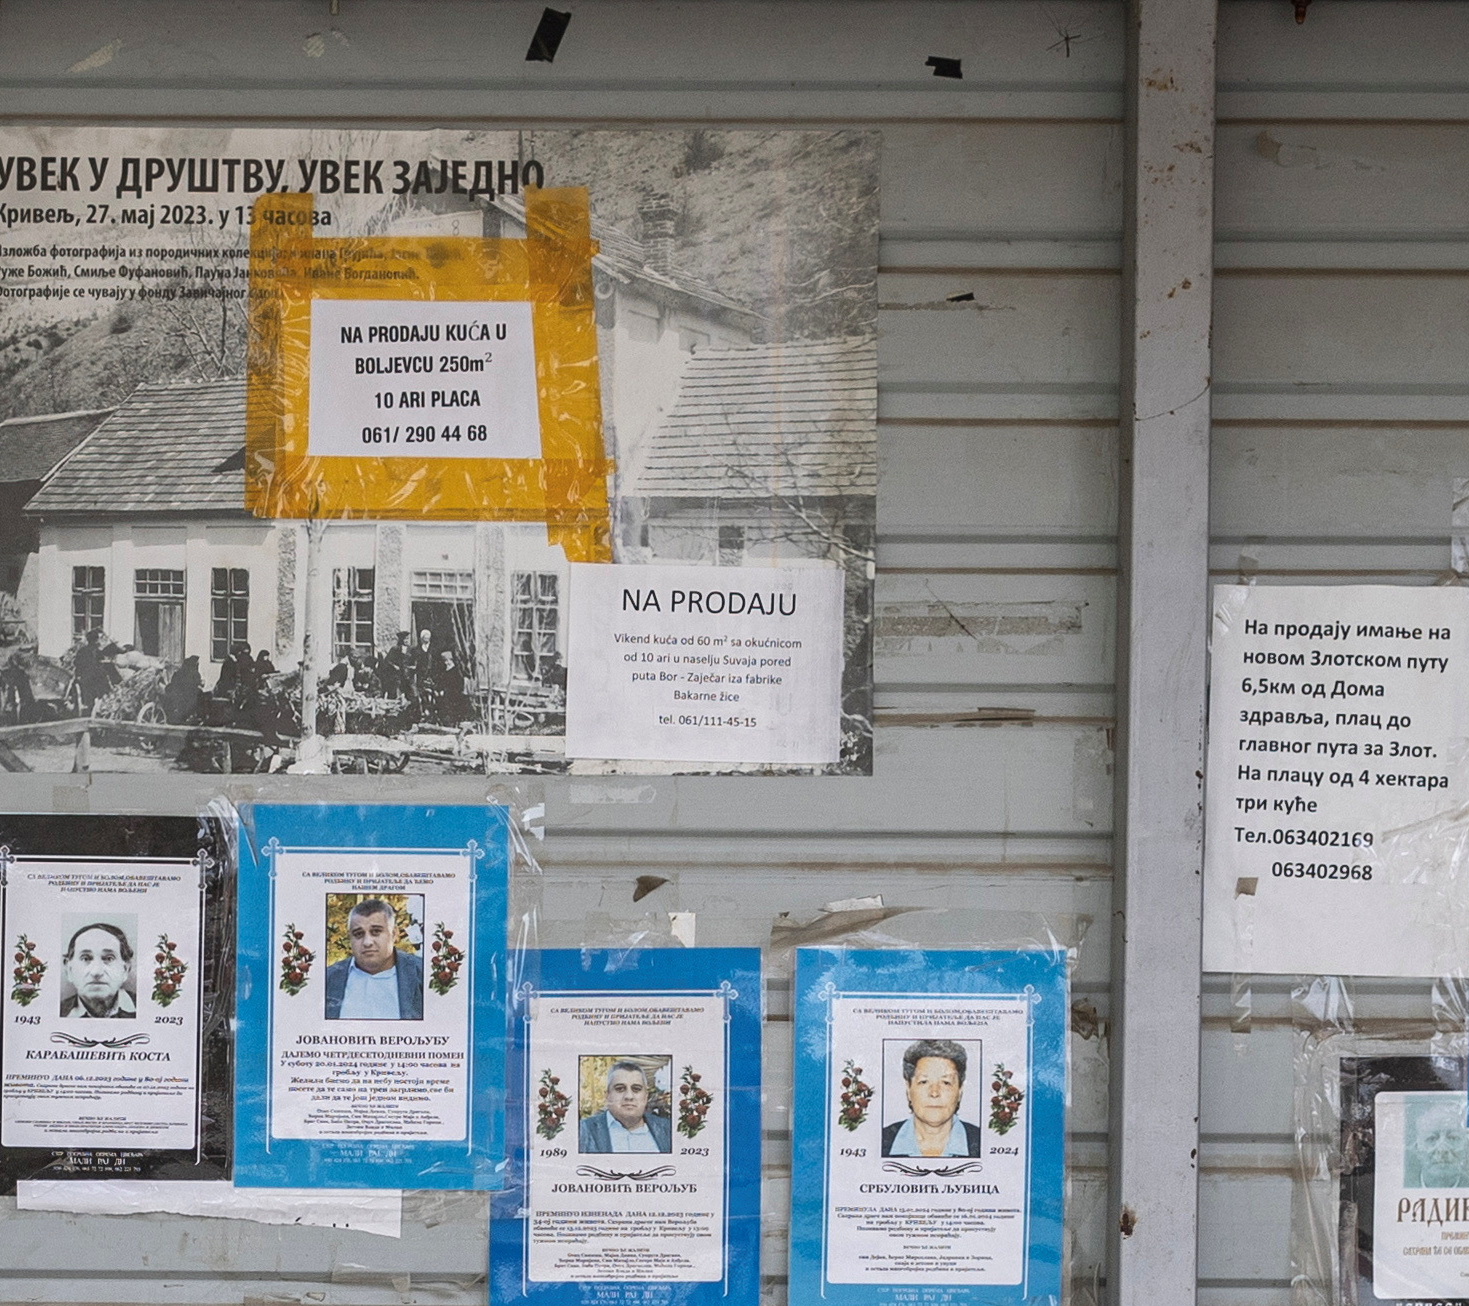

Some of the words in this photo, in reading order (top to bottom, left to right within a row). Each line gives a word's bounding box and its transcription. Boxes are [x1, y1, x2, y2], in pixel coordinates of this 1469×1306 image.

[88, 158, 109, 192] У
[116, 157, 290, 198] ДРУШТВУ,
[299, 160, 383, 193] УВЕК
[393, 160, 545, 201] ЗАЈЕДНО
[86, 206, 116, 225] 27.
[122, 204, 155, 228] мај
[161, 207, 214, 226] 2023.
[219, 209, 230, 229] у
[236, 207, 255, 225] 13
[262, 211, 332, 227] часова
[341, 327, 362, 343] NA
[369, 325, 440, 342] PRODAJU
[446, 321, 490, 340] KUĆA
[496, 324, 507, 340] U
[355, 357, 433, 374] BOLJEVCU
[375, 392, 393, 408] 10
[399, 392, 425, 408] ARI
[432, 390, 480, 407] PLACA
[362, 427, 399, 443] 061/
[406, 426, 435, 442] 290
[441, 426, 461, 441] 44
[468, 425, 487, 441] 68
[623, 589, 660, 612] NA
[672, 591, 797, 616] PRODAJU
[1245, 620, 1268, 635] На
[1274, 621, 1350, 639] продају
[1357, 625, 1422, 639] имање
[1429, 628, 1450, 639] на
[1243, 652, 1304, 665] новом
[1311, 651, 1401, 668] Злотском
[1407, 657, 1448, 673] путу
[674, 690, 716, 701] Bakarne
[720, 691, 740, 701] žice
[1242, 679, 1295, 695] 6,5км
[1302, 683, 1325, 698] од
[1332, 681, 1384, 698] Дома
[659, 715, 675, 724] tel.
[679, 715, 756, 727] 061/111-45-15
[1236, 796, 1267, 812] три
[1274, 796, 1317, 814] куће
[1235, 827, 1373, 847] Тел.063402169
[1272, 862, 1372, 880] 063402968
[296, 1035, 376, 1045] ЈОВАНОВИЋ
[380, 1036, 450, 1046] ВЕРОЉУБУ
[26, 1051, 126, 1060] КАРАБАШЕВИЋ
[130, 1052, 171, 1062] КОСТА
[552, 1183, 633, 1193] ЈОВАНОВИЋ
[636, 1184, 697, 1193] ВЕРОЉУБ
[860, 1183, 939, 1194] СРБУЛОВИЋ
[942, 1184, 1000, 1195] ЉУБИЦА
